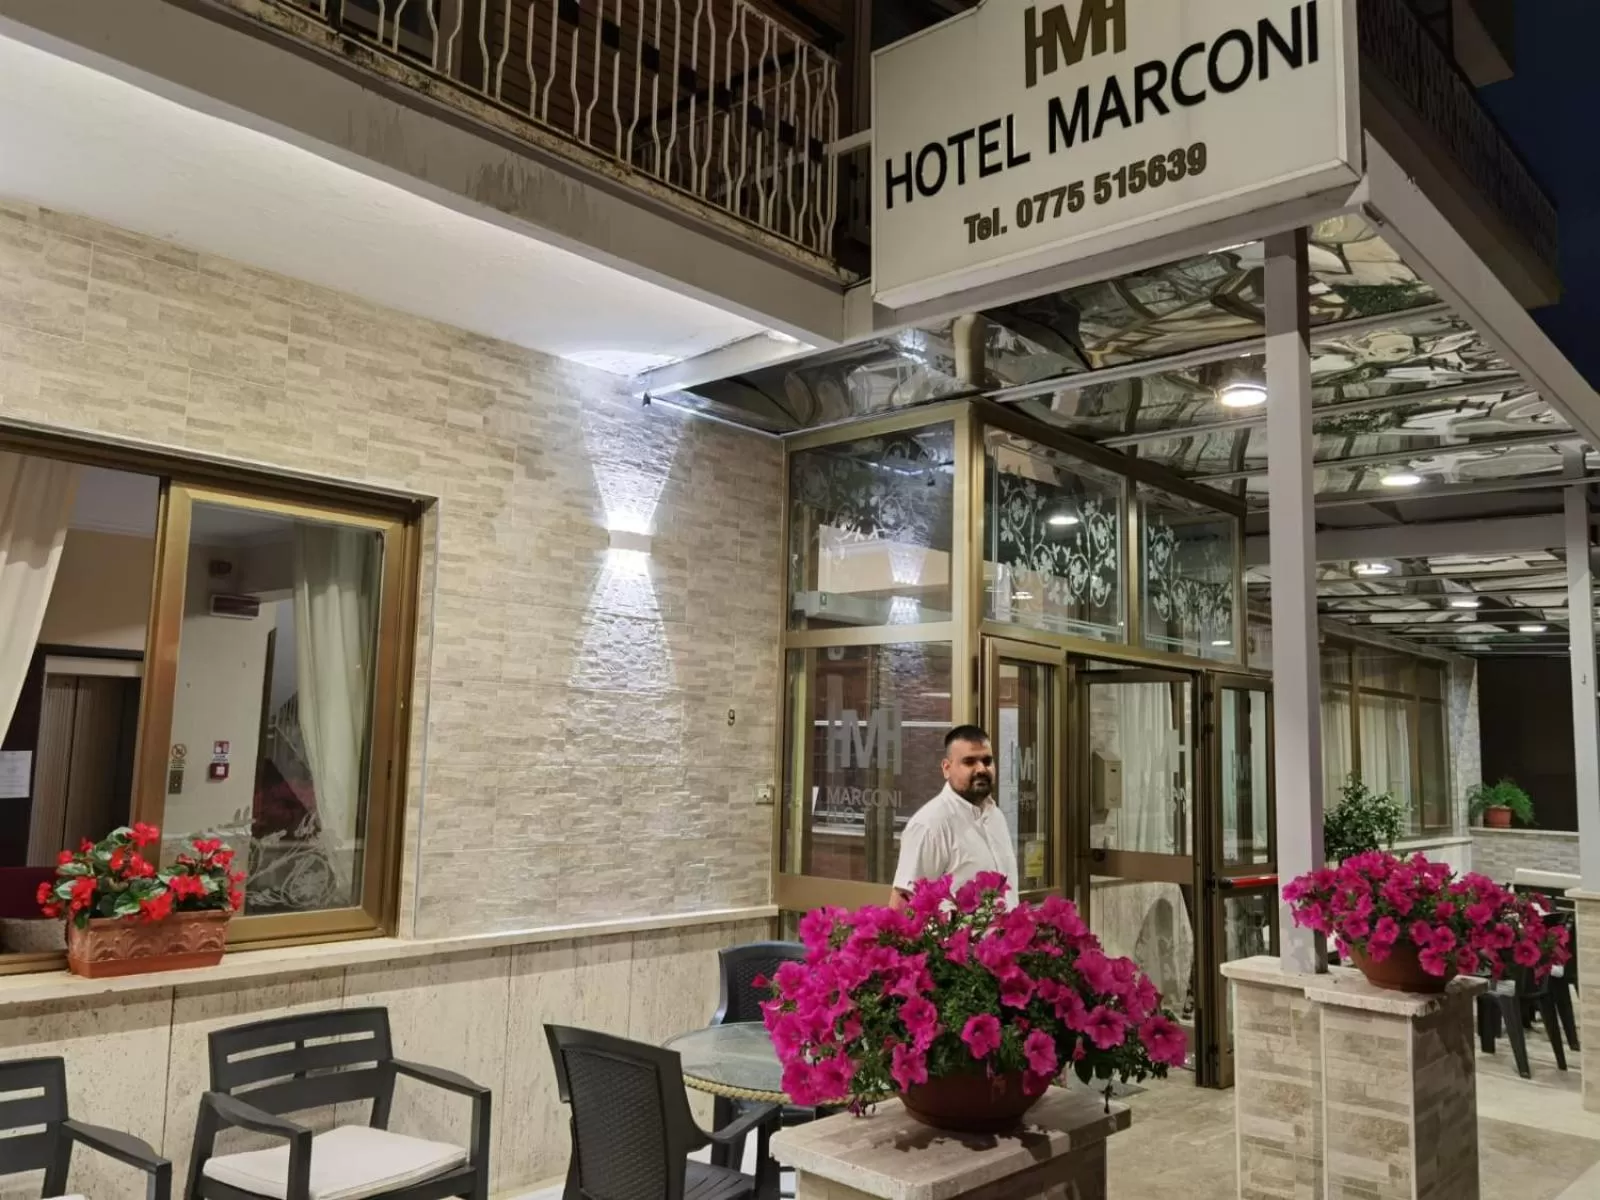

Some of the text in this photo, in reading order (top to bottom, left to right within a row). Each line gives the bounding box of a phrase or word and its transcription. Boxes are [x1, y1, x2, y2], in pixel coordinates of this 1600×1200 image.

[1024, 0, 1126, 89] HMH
[885, 0, 1319, 210] HOTEL MARCONI
[963, 142, 1207, 245] Tel. 0775 515639
[727, 708, 736, 727] 9
[827, 786, 902, 809] MARCONI
